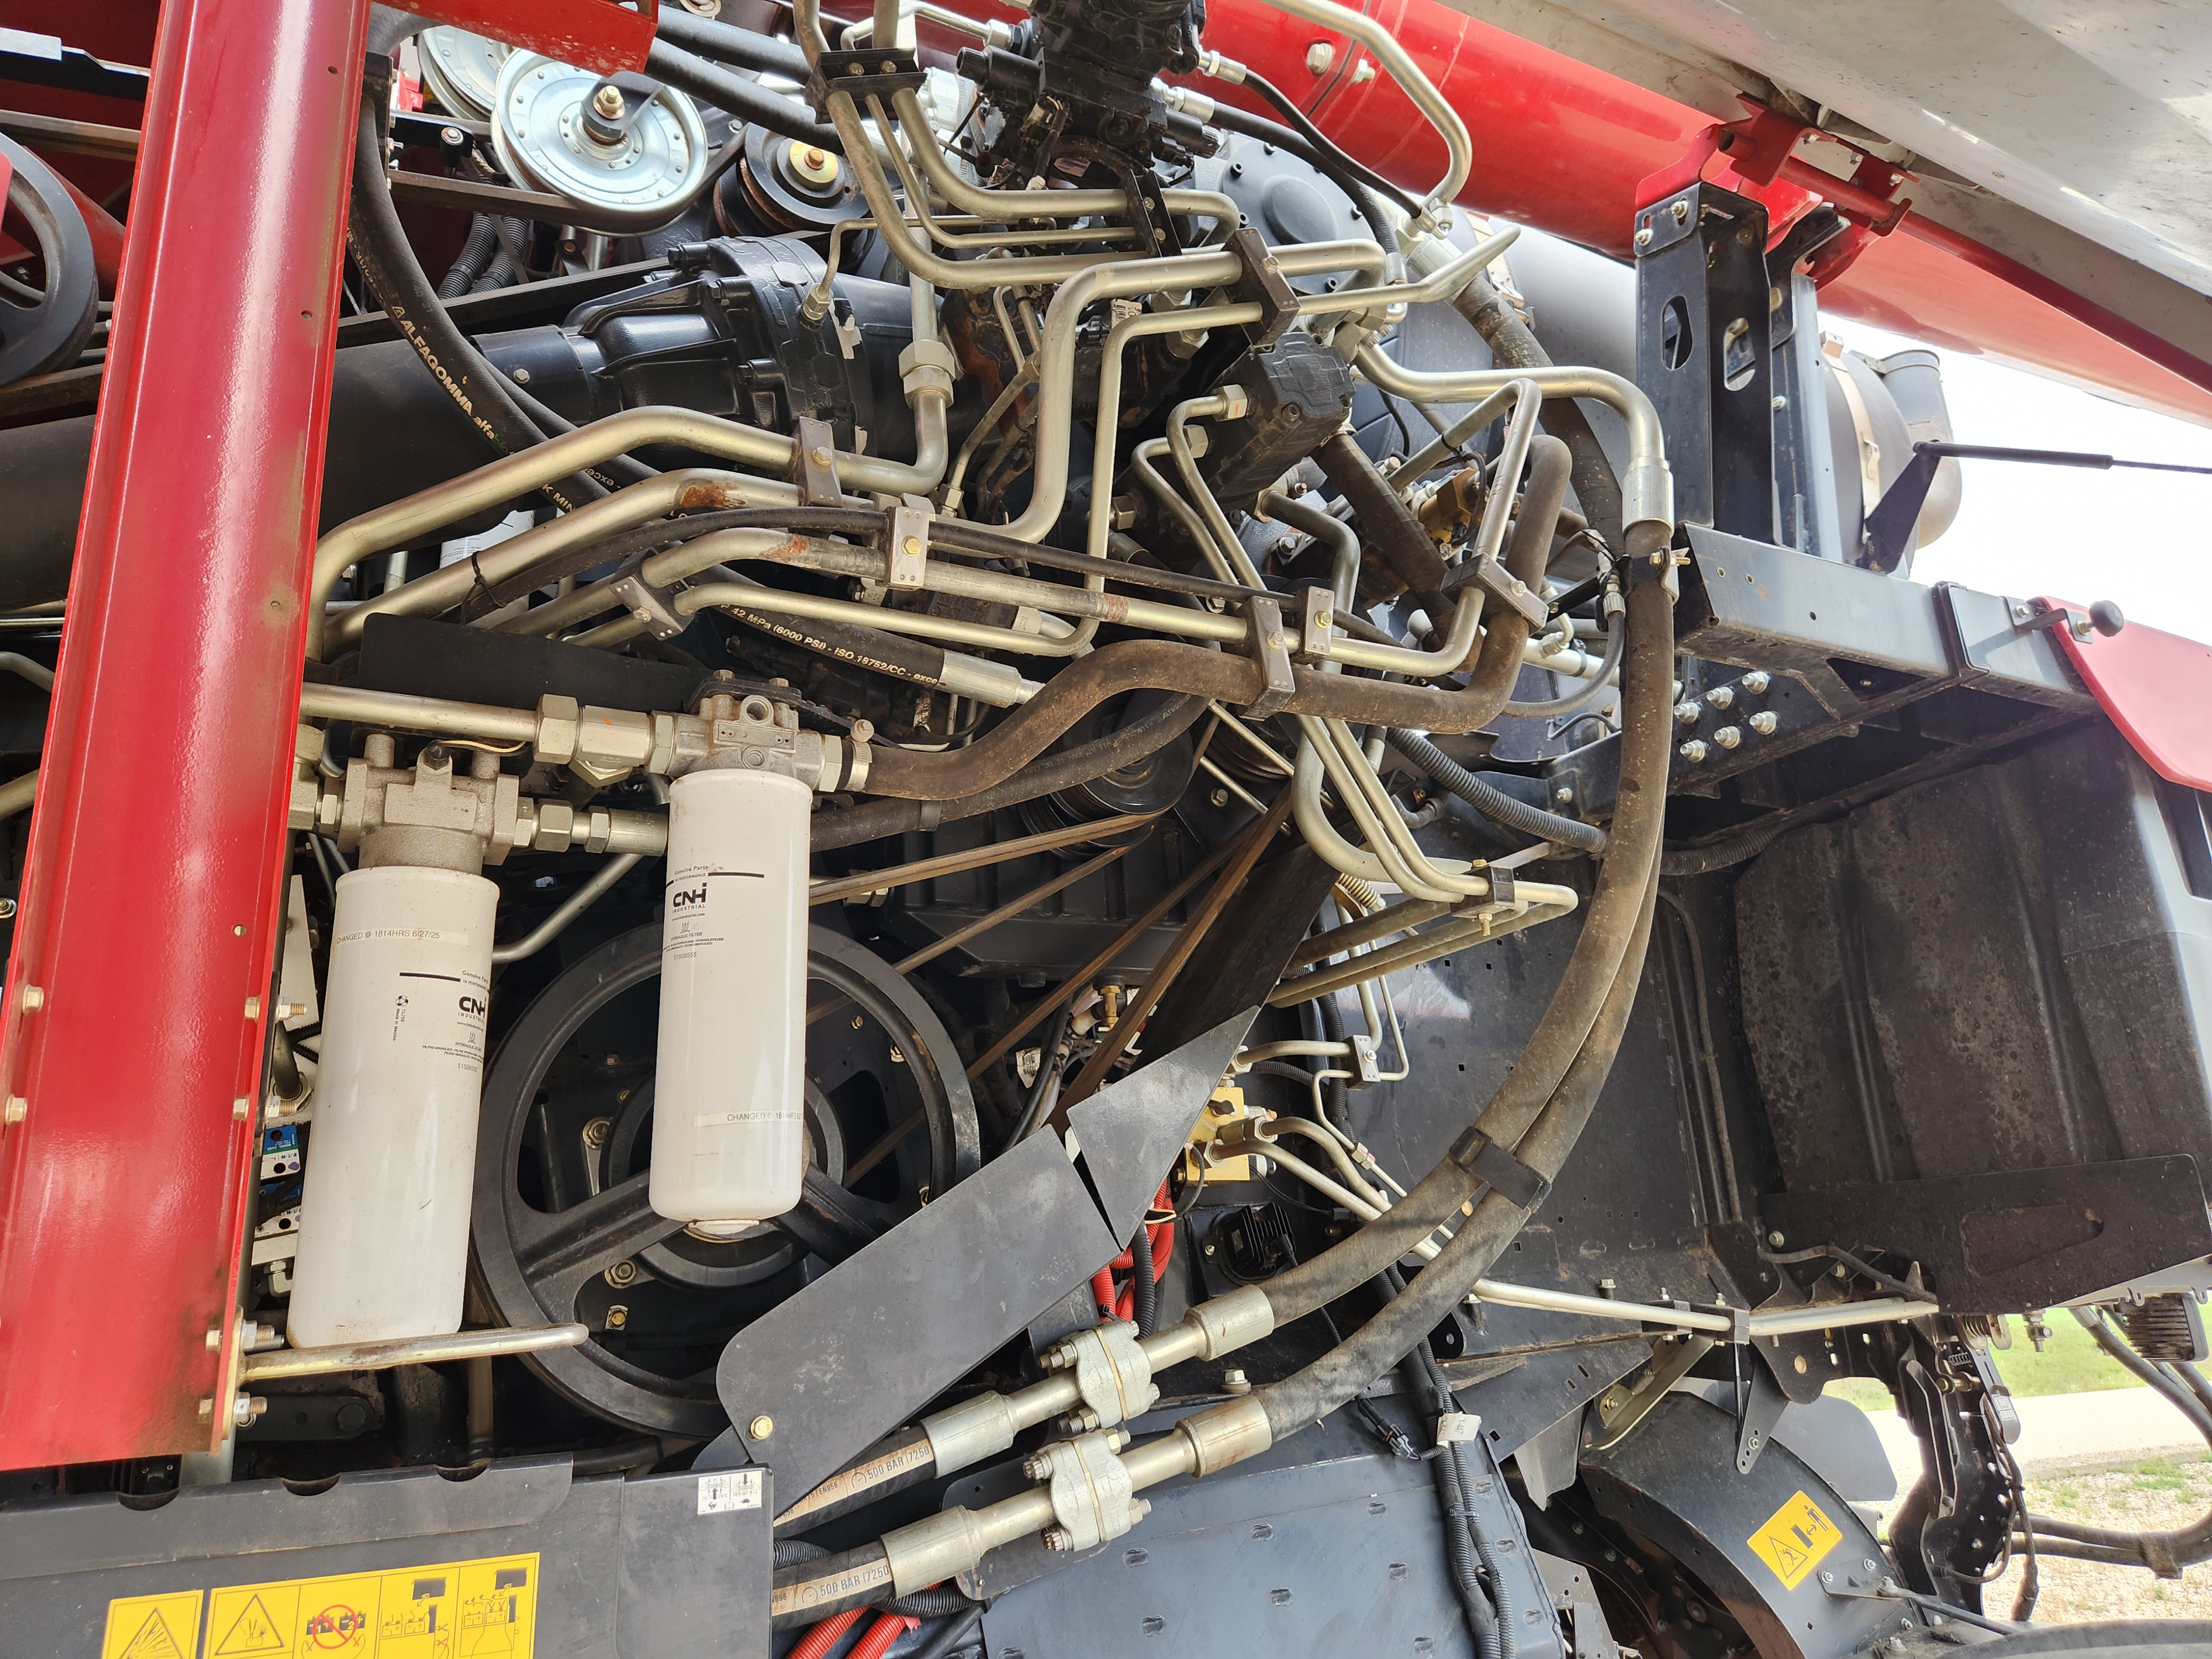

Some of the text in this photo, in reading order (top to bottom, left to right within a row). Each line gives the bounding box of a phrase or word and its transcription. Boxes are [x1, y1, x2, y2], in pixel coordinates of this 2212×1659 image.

[400, 320, 472, 416] ALFAGOMMA
[731, 607, 746, 618] 42
[747, 614, 771, 629] MPa
[773, 624, 803, 641] (6000
[804, 637, 826, 650] PSI)
[833, 647, 854, 659] ISO
[857, 655, 906, 676] 18752/CC
[675, 867, 692, 875] Genuine
[679, 873, 706, 881] PERFORMANCE
[672, 905, 706, 914] INDUSTRIAL
[336, 932, 363, 945] CHANGED
[374, 930, 410, 938] 1814HRS
[412, 930, 441, 939] 6/27/25
[673, 952, 697, 961] 51508555
[462, 970, 481, 980] Genuine
[727, 1112, 765, 1121] CHANGED
[867, 1445, 930, 1479] 500 BAR (7250
[820, 1564, 889, 1597] 500 BAR (7250
